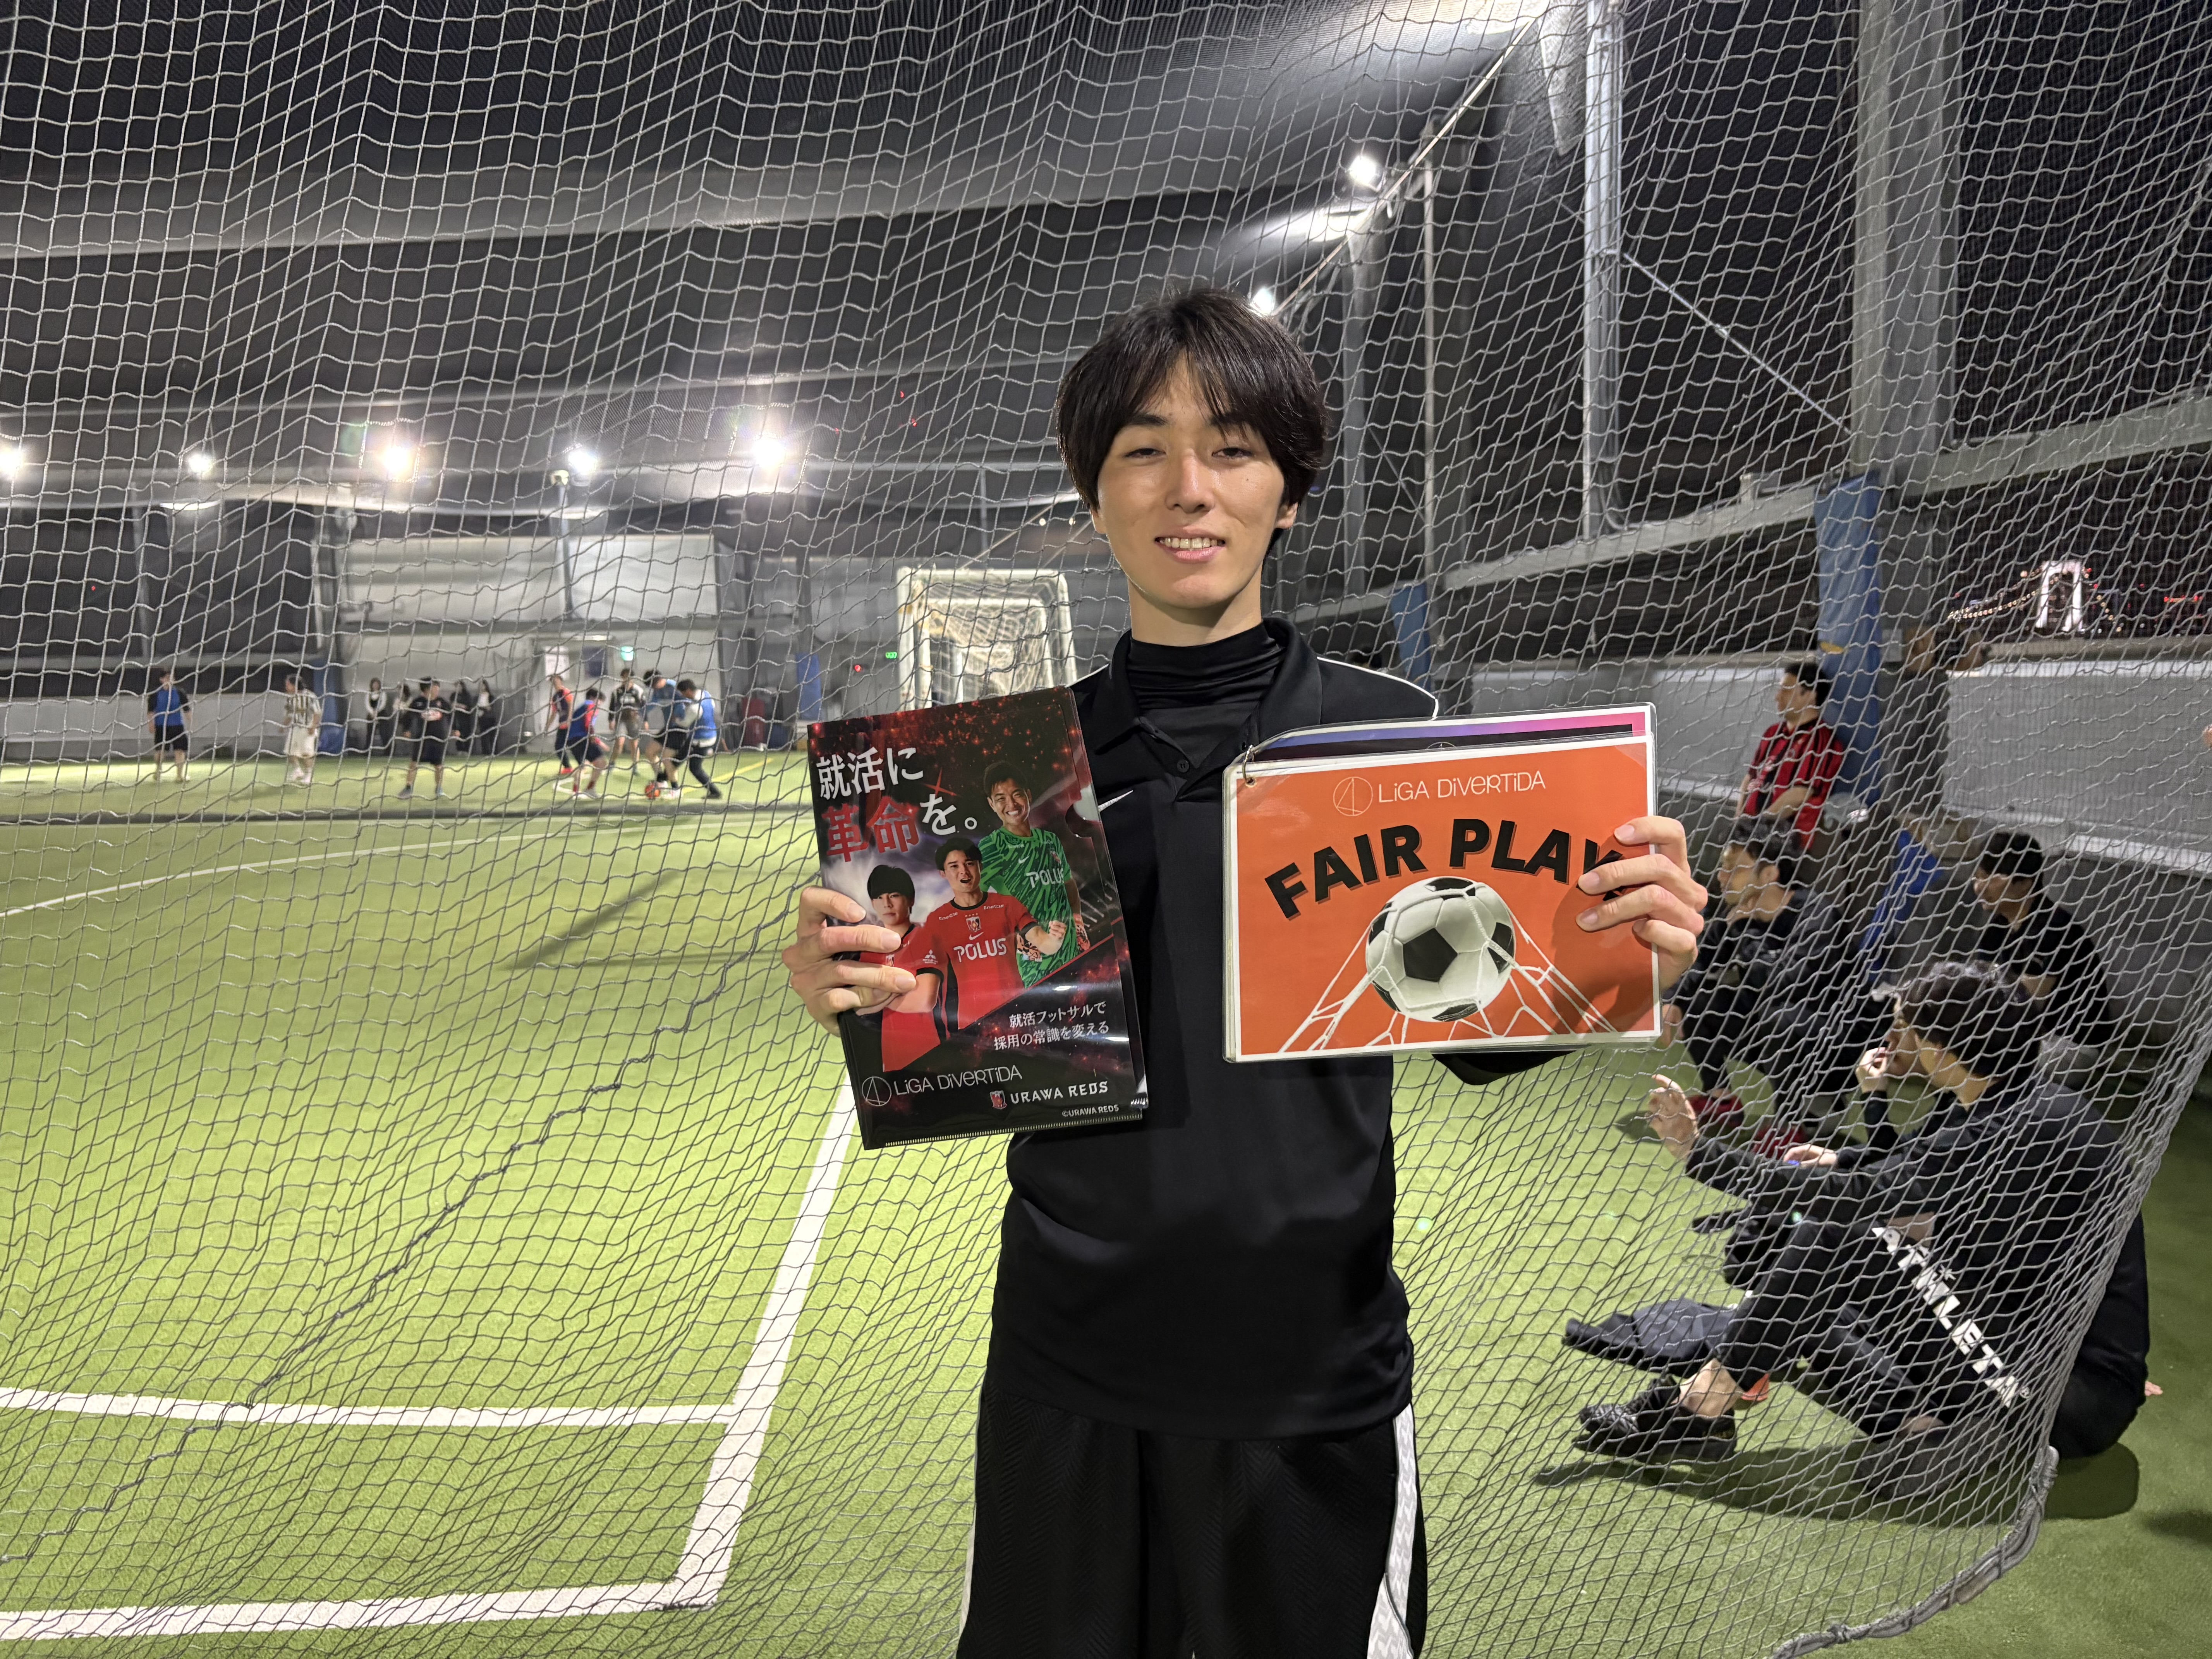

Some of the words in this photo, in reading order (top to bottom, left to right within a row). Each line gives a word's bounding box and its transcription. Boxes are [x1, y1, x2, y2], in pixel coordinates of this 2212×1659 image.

[816, 746, 924, 800] 就活に
[821, 793, 977, 862] 革命を。
[1264, 824, 1428, 920] FAIR
[1449, 818, 1625, 902] PLAY
[953, 938, 1007, 963] POLUS
[1009, 1001, 1106, 1028] 就活フットサルで
[994, 1020, 1109, 1051] 採用の常識を変える
[1010, 1087, 1064, 1104] URAWA
[1068, 1081, 1109, 1097] REDS
[1098, 1104, 1120, 1114] REDS
